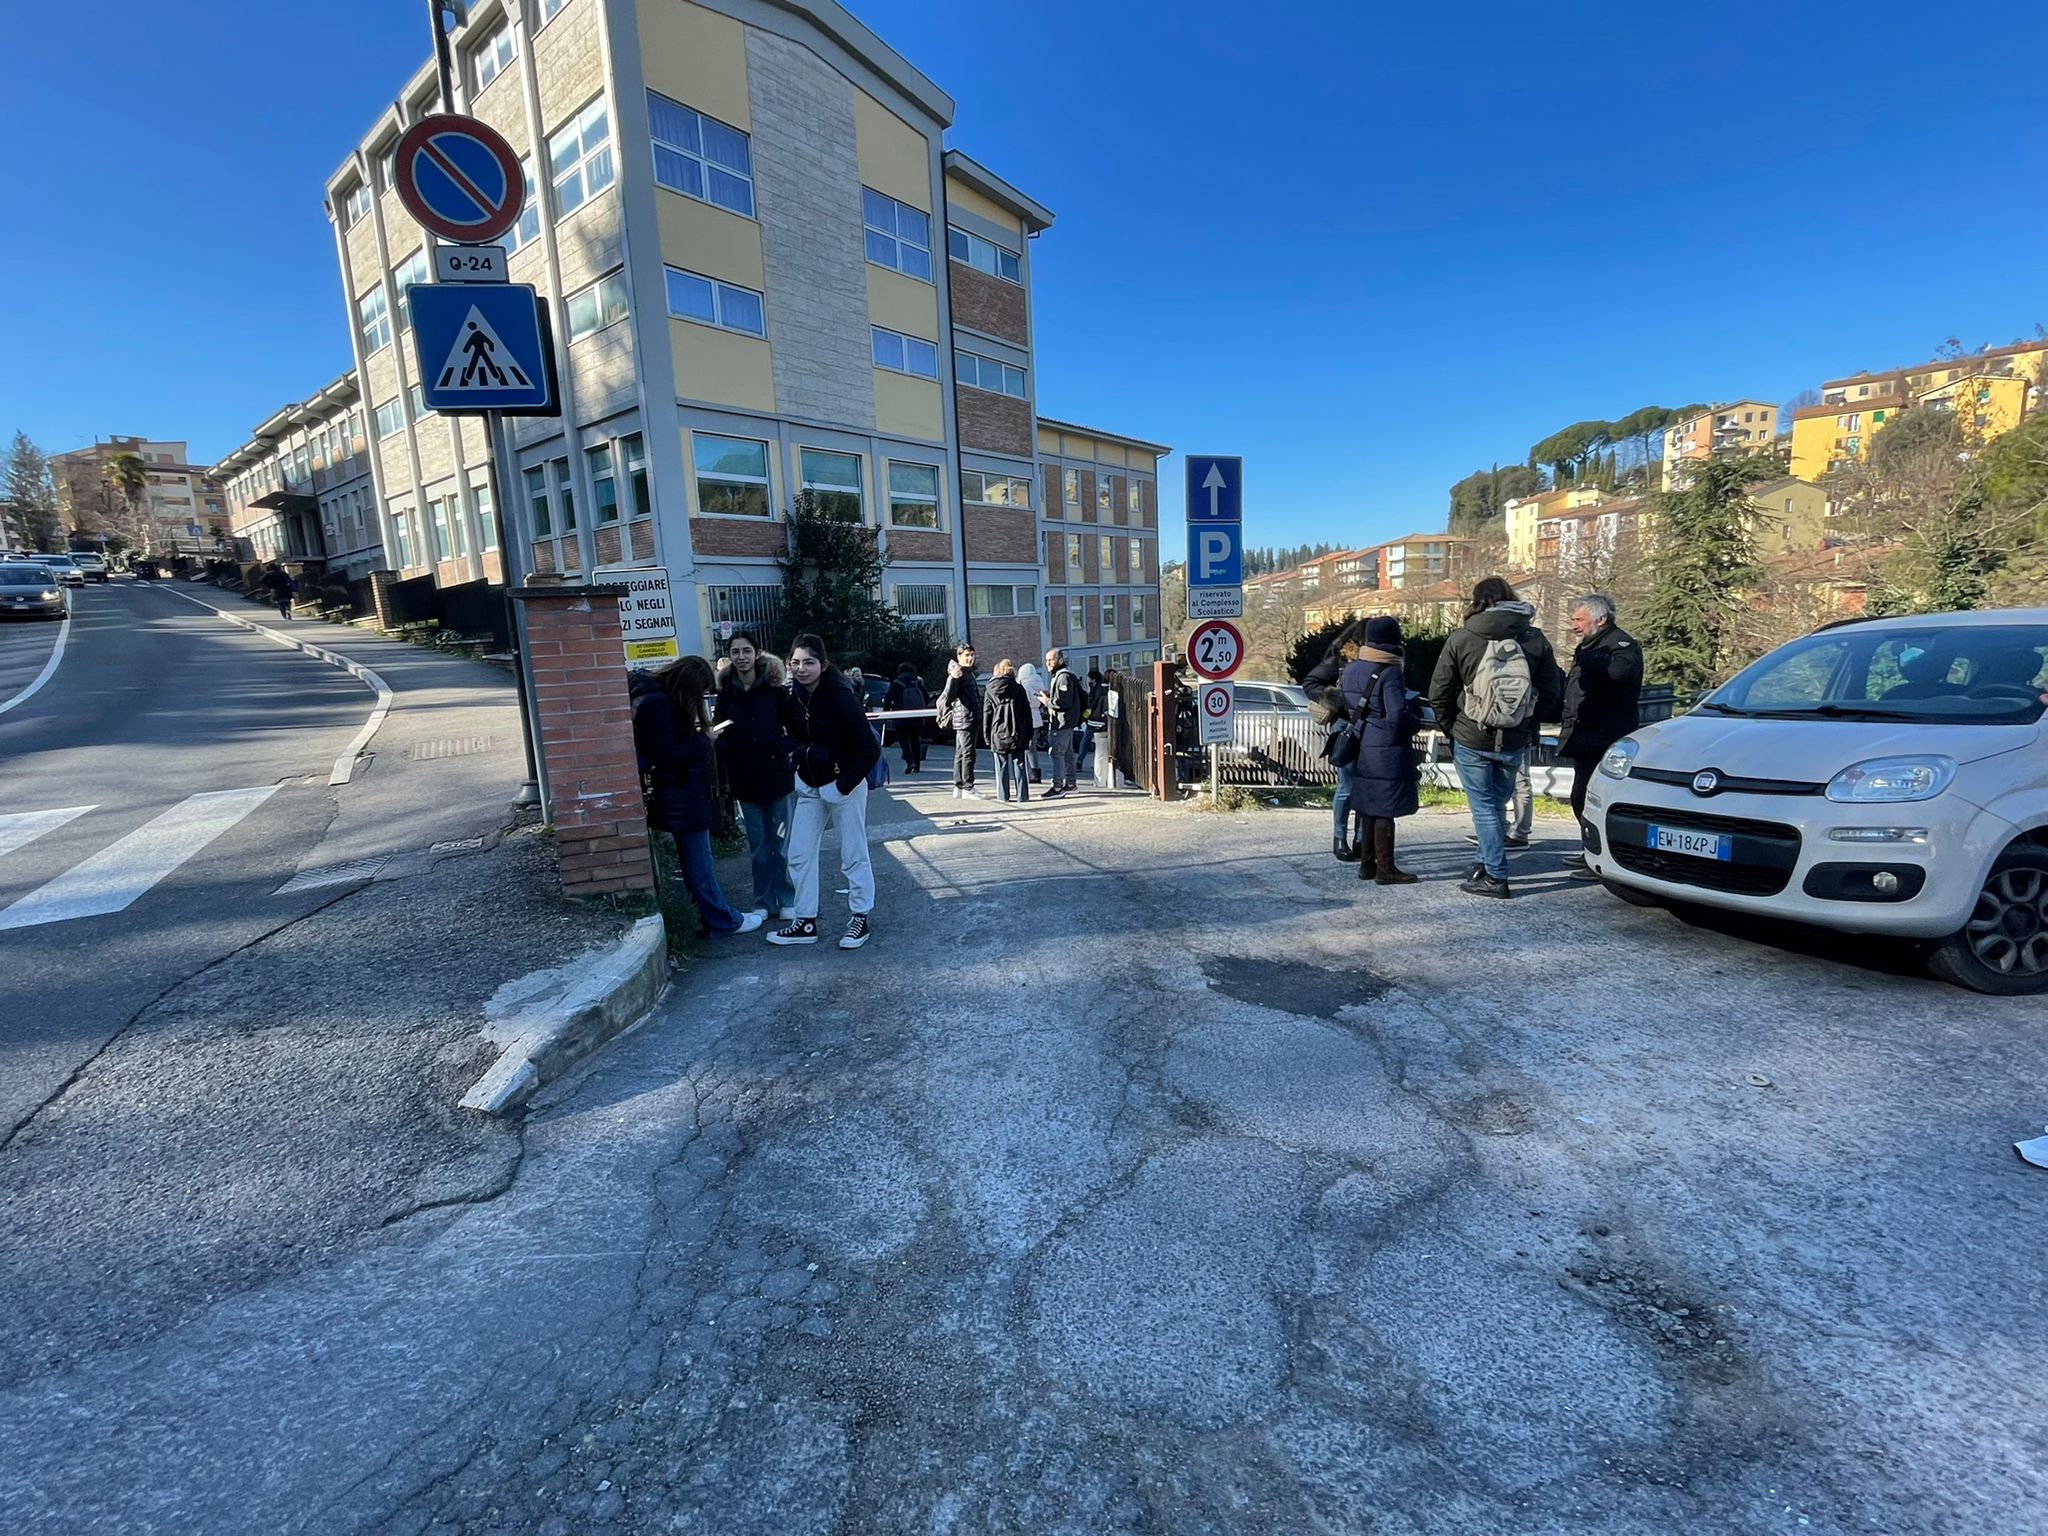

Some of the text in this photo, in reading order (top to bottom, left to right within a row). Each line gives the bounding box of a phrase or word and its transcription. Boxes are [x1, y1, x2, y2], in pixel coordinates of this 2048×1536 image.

[1200, 531, 1231, 579] P
[598, 579, 667, 592] GGIARE
[620, 598, 665, 612] LO NEGLI
[1197, 608, 1234, 616] Scolastico
[635, 616, 674, 630] SEGNATI
[1218, 636, 1227, 645] m
[1211, 696, 1223, 708] 30
